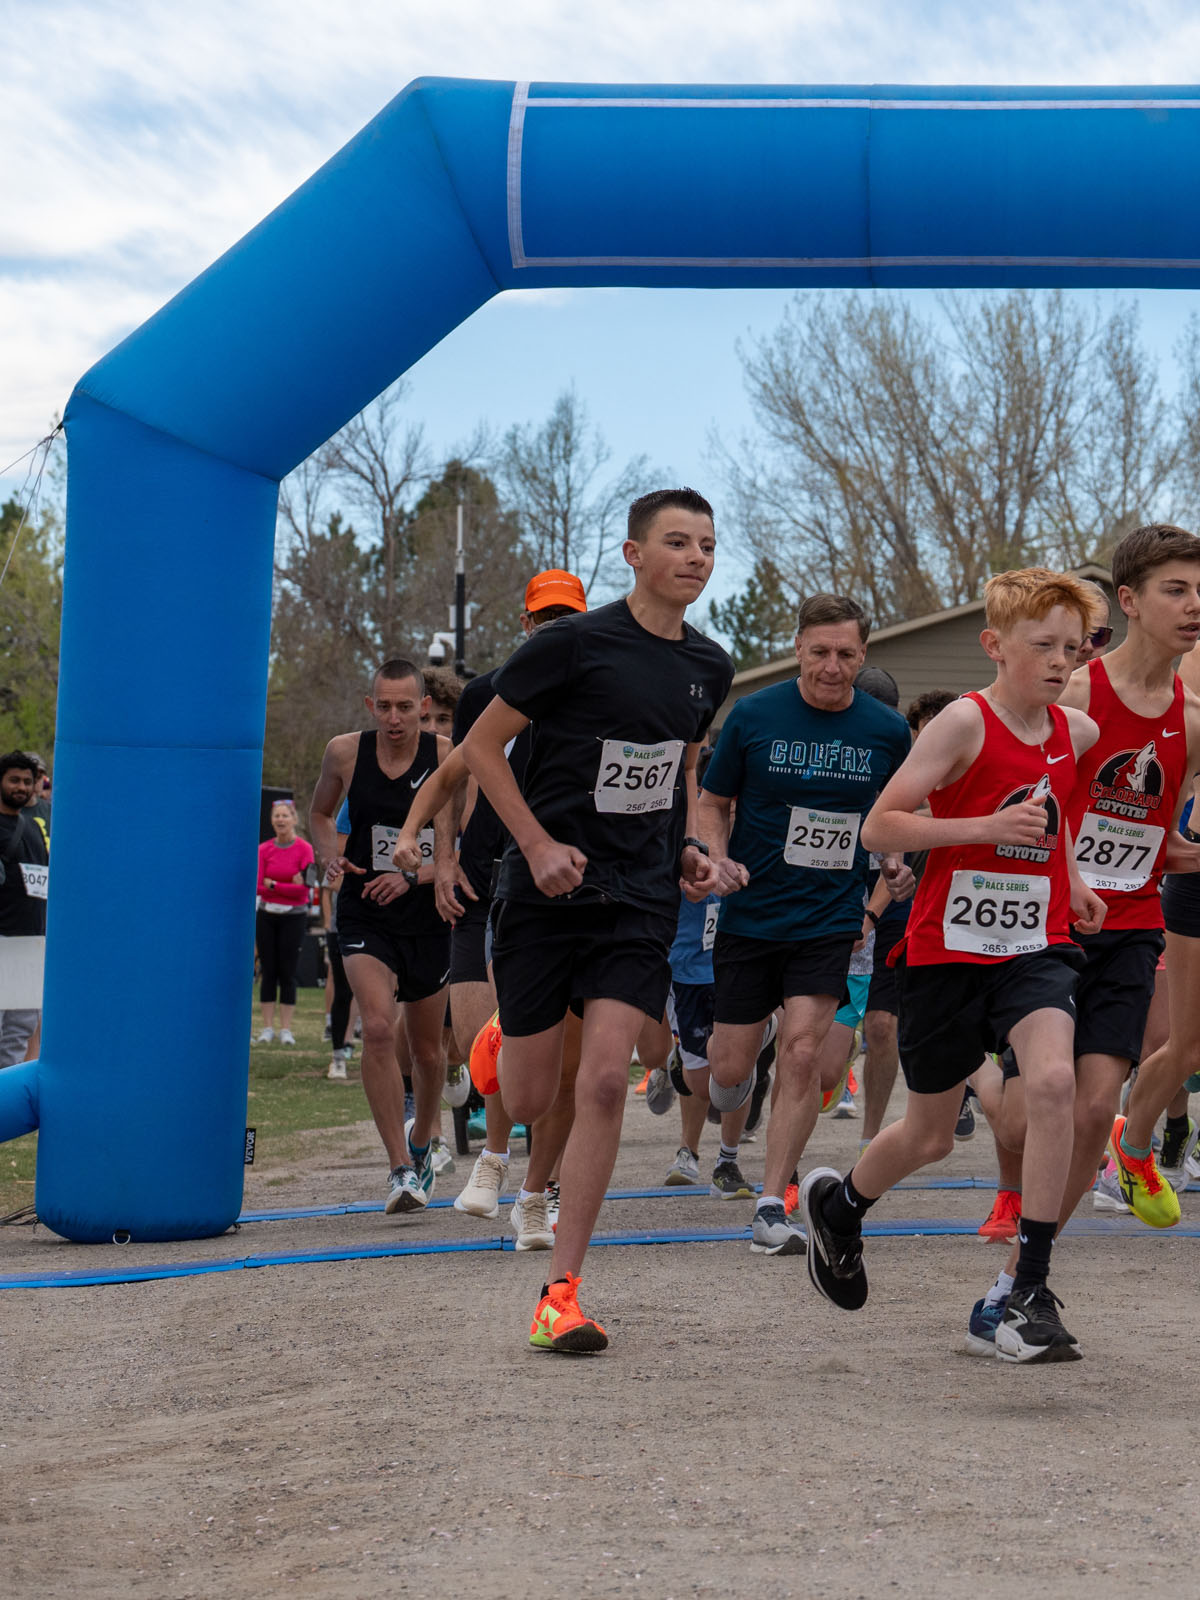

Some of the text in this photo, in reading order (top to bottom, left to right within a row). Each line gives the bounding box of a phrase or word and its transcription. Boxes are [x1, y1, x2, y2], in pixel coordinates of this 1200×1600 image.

[633, 749, 666, 760] RACE SERIES
[770, 740, 872, 774] COLFAX
[603, 761, 674, 790] 2567
[1090, 781, 1161, 809] COLORADO
[626, 798, 668, 812] 2567 2567
[817, 816, 831, 824] RACE
[792, 826, 852, 850] 2576
[1107, 825, 1145, 838] RACE SERIES
[377, 840, 433, 858] 26
[1076, 836, 1152, 871] 2877
[811, 859, 829, 867] 2576
[985, 881, 1005, 891] RACE
[1005, 883, 1030, 892] SERIES
[1096, 879, 1117, 888] 2877
[950, 895, 1041, 930] 2653
[982, 943, 1043, 954] 2653 2653
[245, 1131, 255, 1163] VEVOR
